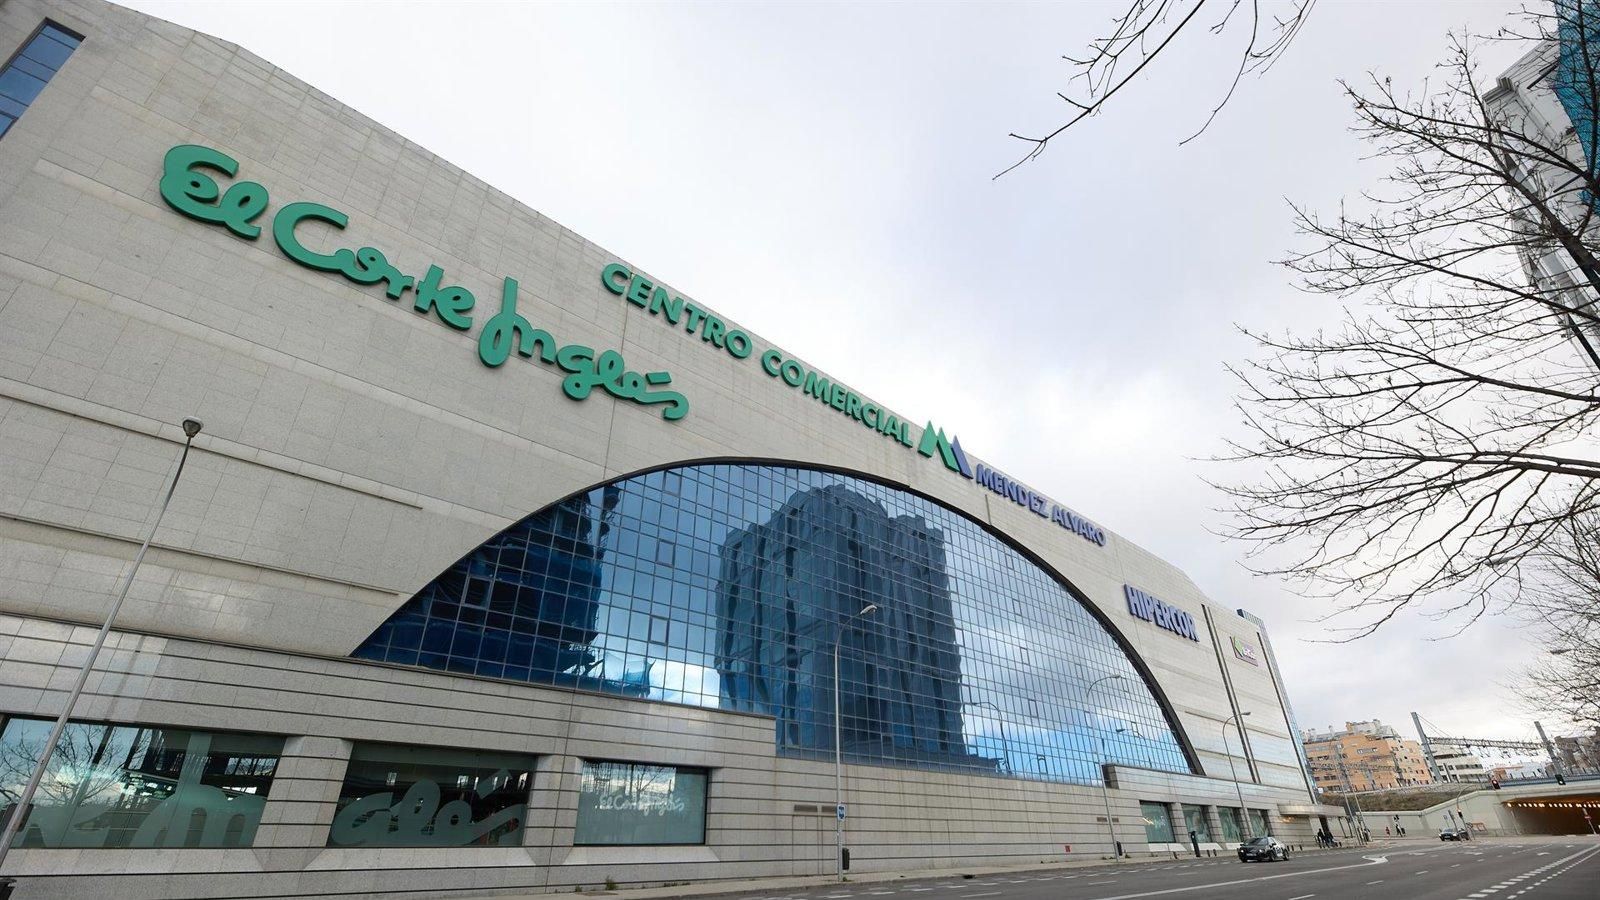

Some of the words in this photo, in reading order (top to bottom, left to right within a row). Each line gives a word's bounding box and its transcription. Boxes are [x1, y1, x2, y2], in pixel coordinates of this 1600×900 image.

[160, 144, 270, 240] El
[273, 202, 476, 330] Corte
[479, 277, 690, 421] Inglés
[602, 263, 753, 359] CENTRO
[762, 349, 913, 449] COMERCIAL
[976, 463, 1050, 519] MENDEZ
[1052, 505, 1107, 547] ALVARO
[1124, 584, 1199, 642] HIPERCOR
